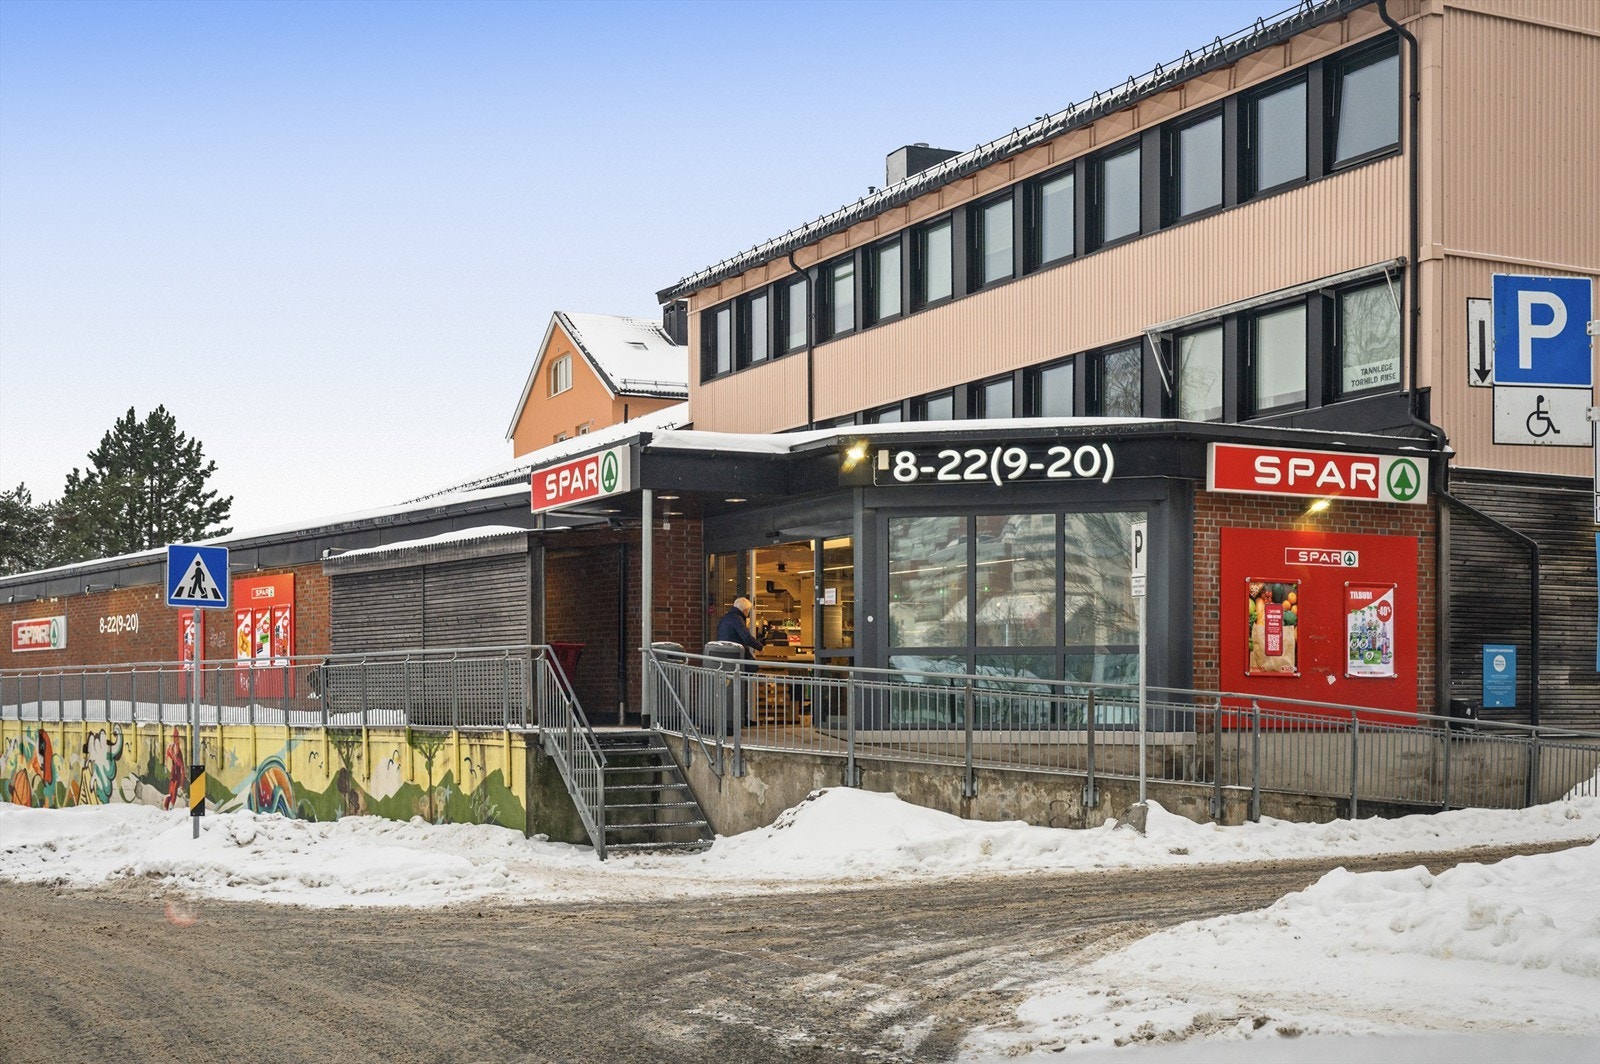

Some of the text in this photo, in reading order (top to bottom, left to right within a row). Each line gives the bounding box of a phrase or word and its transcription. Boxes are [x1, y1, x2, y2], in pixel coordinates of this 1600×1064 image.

[1517, 290, 1568, 370] P
[1351, 376, 1379, 387] TORHILD
[1360, 363, 1393, 376] TANNLEGE
[892, 443, 1115, 487] 8-22(9-20)
[1254, 455, 1377, 491] SPAR
[545, 461, 598, 501] SPAR
[1134, 529, 1143, 569] P
[1298, 551, 1341, 563] SPAR
[17, 624, 50, 646] SPAR
[99, 613, 139, 635] 8-22(9-20)
